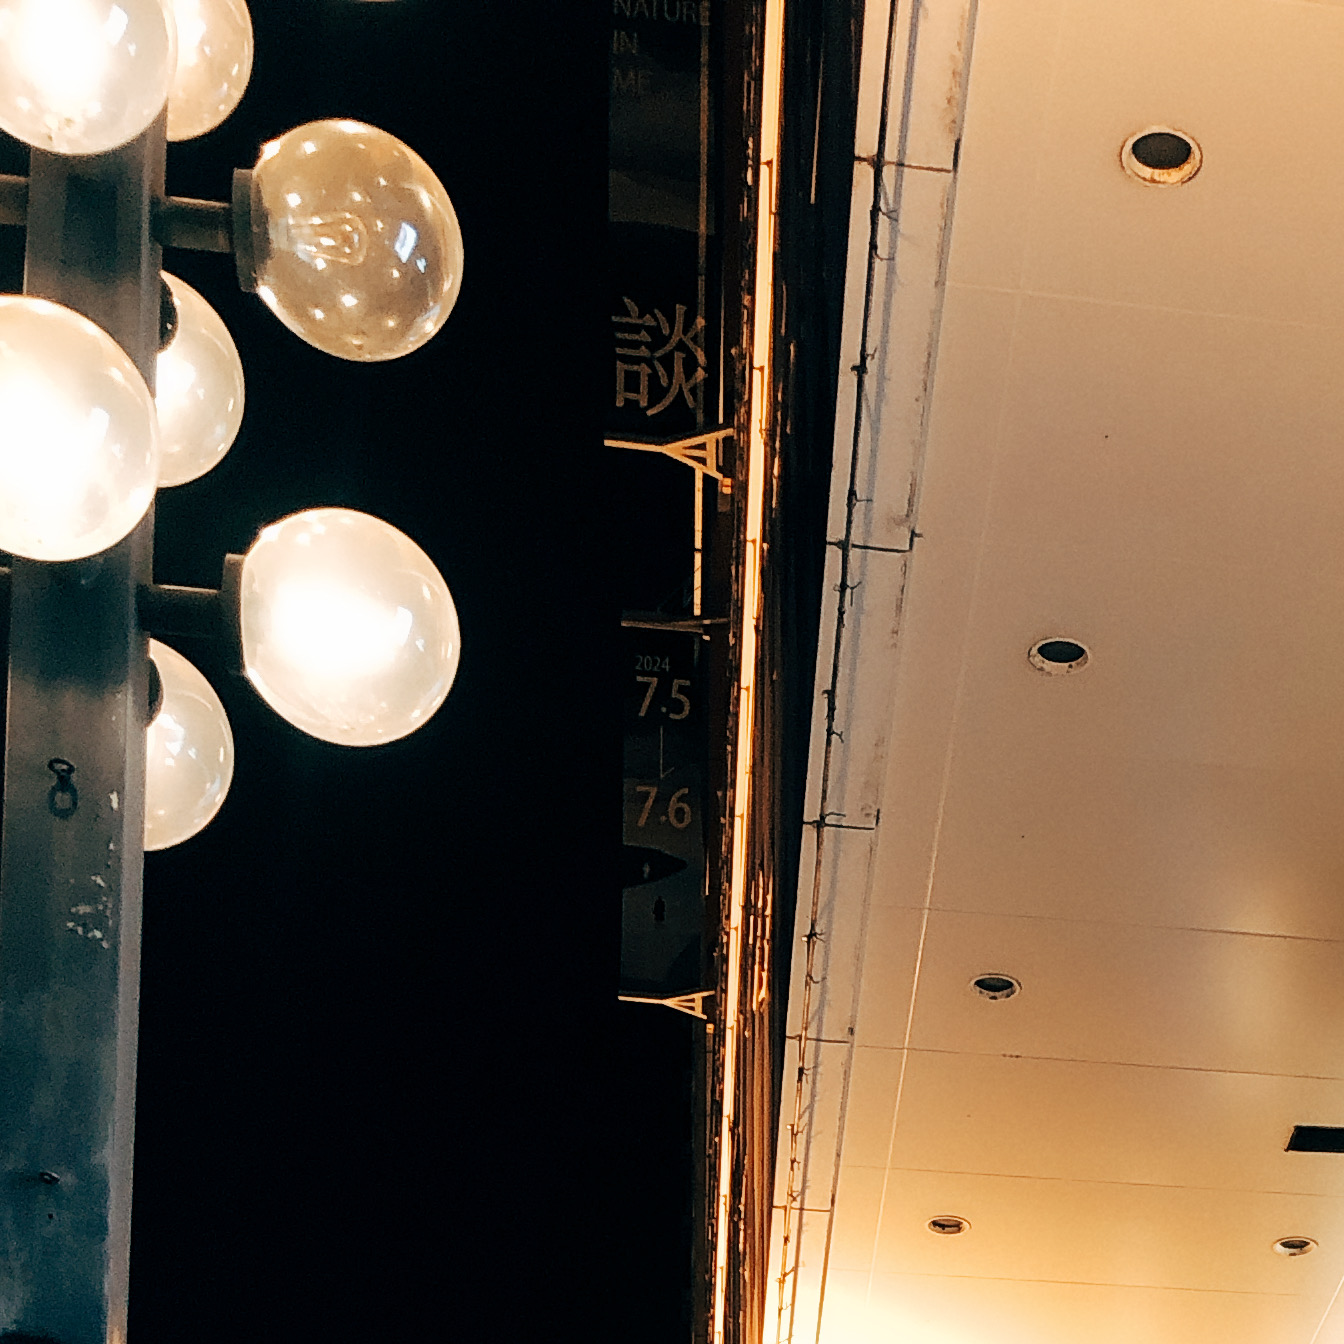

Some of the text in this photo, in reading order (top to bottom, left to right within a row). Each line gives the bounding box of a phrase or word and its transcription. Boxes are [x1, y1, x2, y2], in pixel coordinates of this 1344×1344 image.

[611, 296, 707, 416] 談
[634, 655, 671, 672] 2024
[634, 676, 691, 720] 7.5
[634, 785, 692, 828] 7.6
